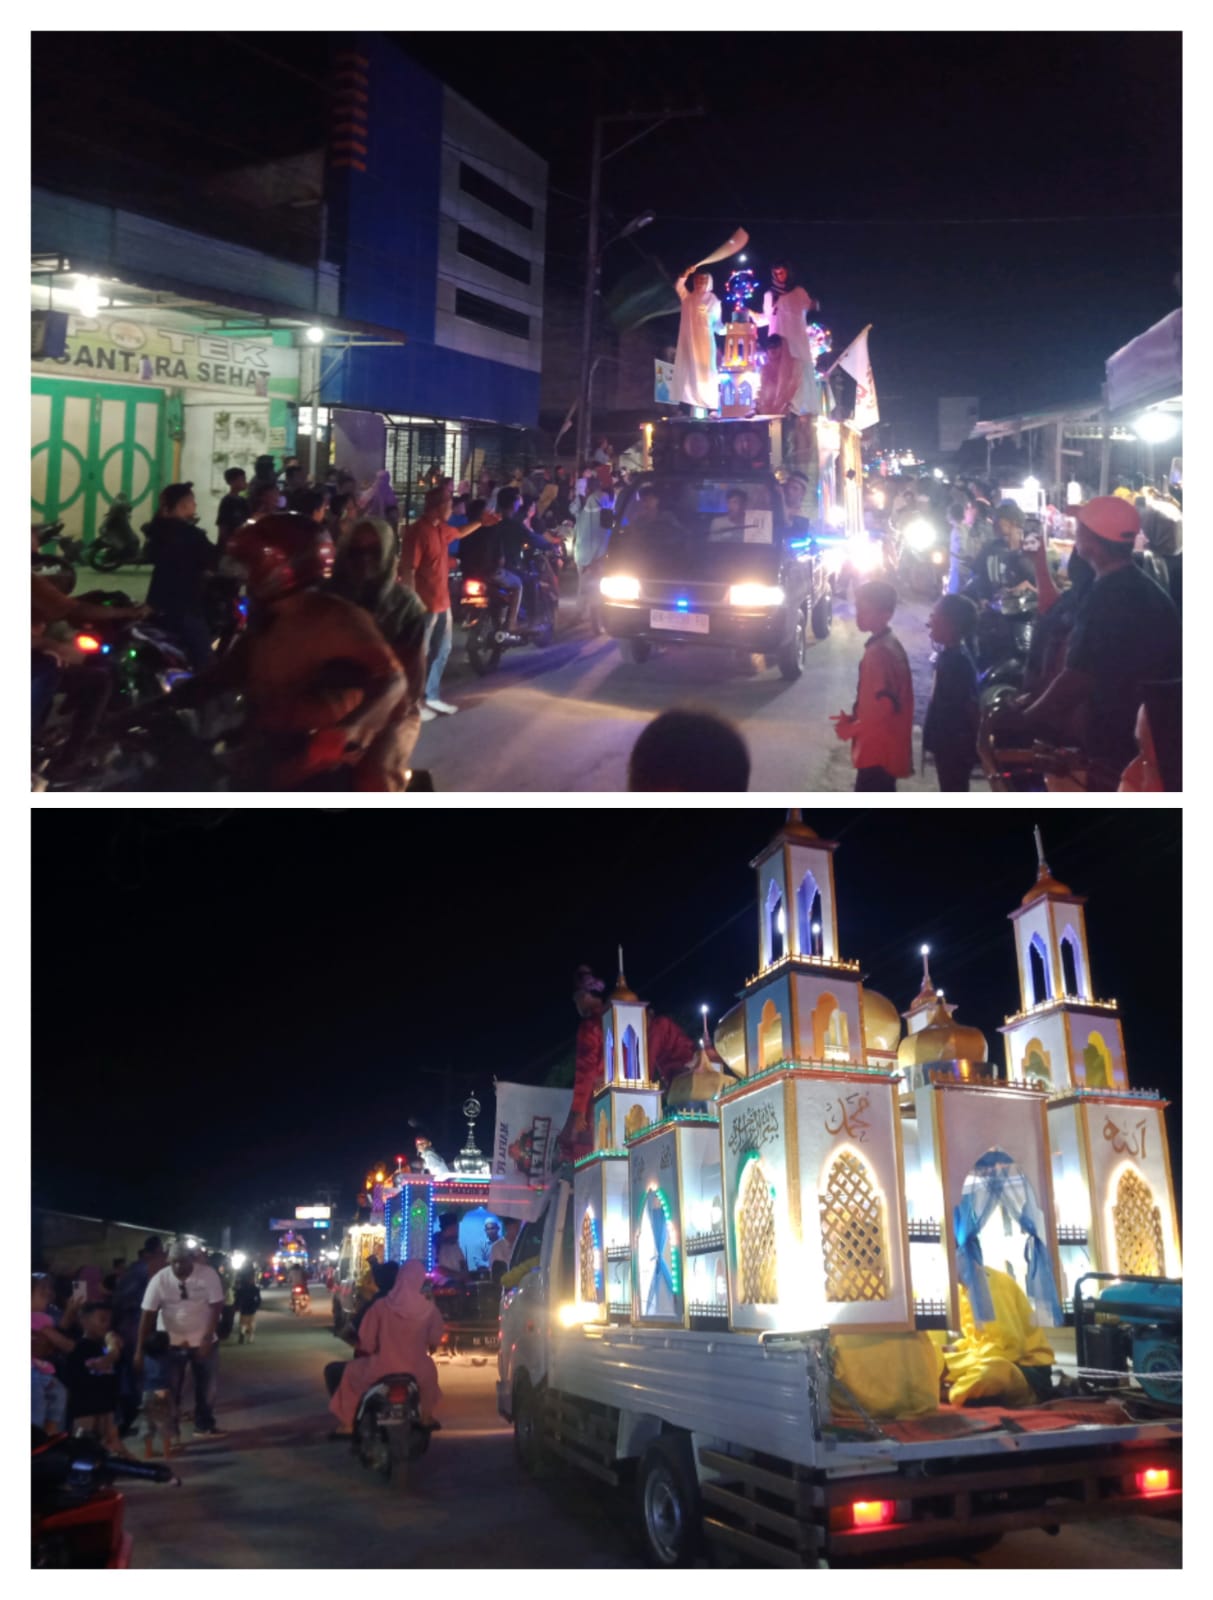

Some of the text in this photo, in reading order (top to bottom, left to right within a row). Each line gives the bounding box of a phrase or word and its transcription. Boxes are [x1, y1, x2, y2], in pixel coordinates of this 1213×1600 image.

[66, 315, 268, 368] POTEK
[197, 361, 271, 389] SEHAT
[1103, 1115, 1147, 1159] الله
